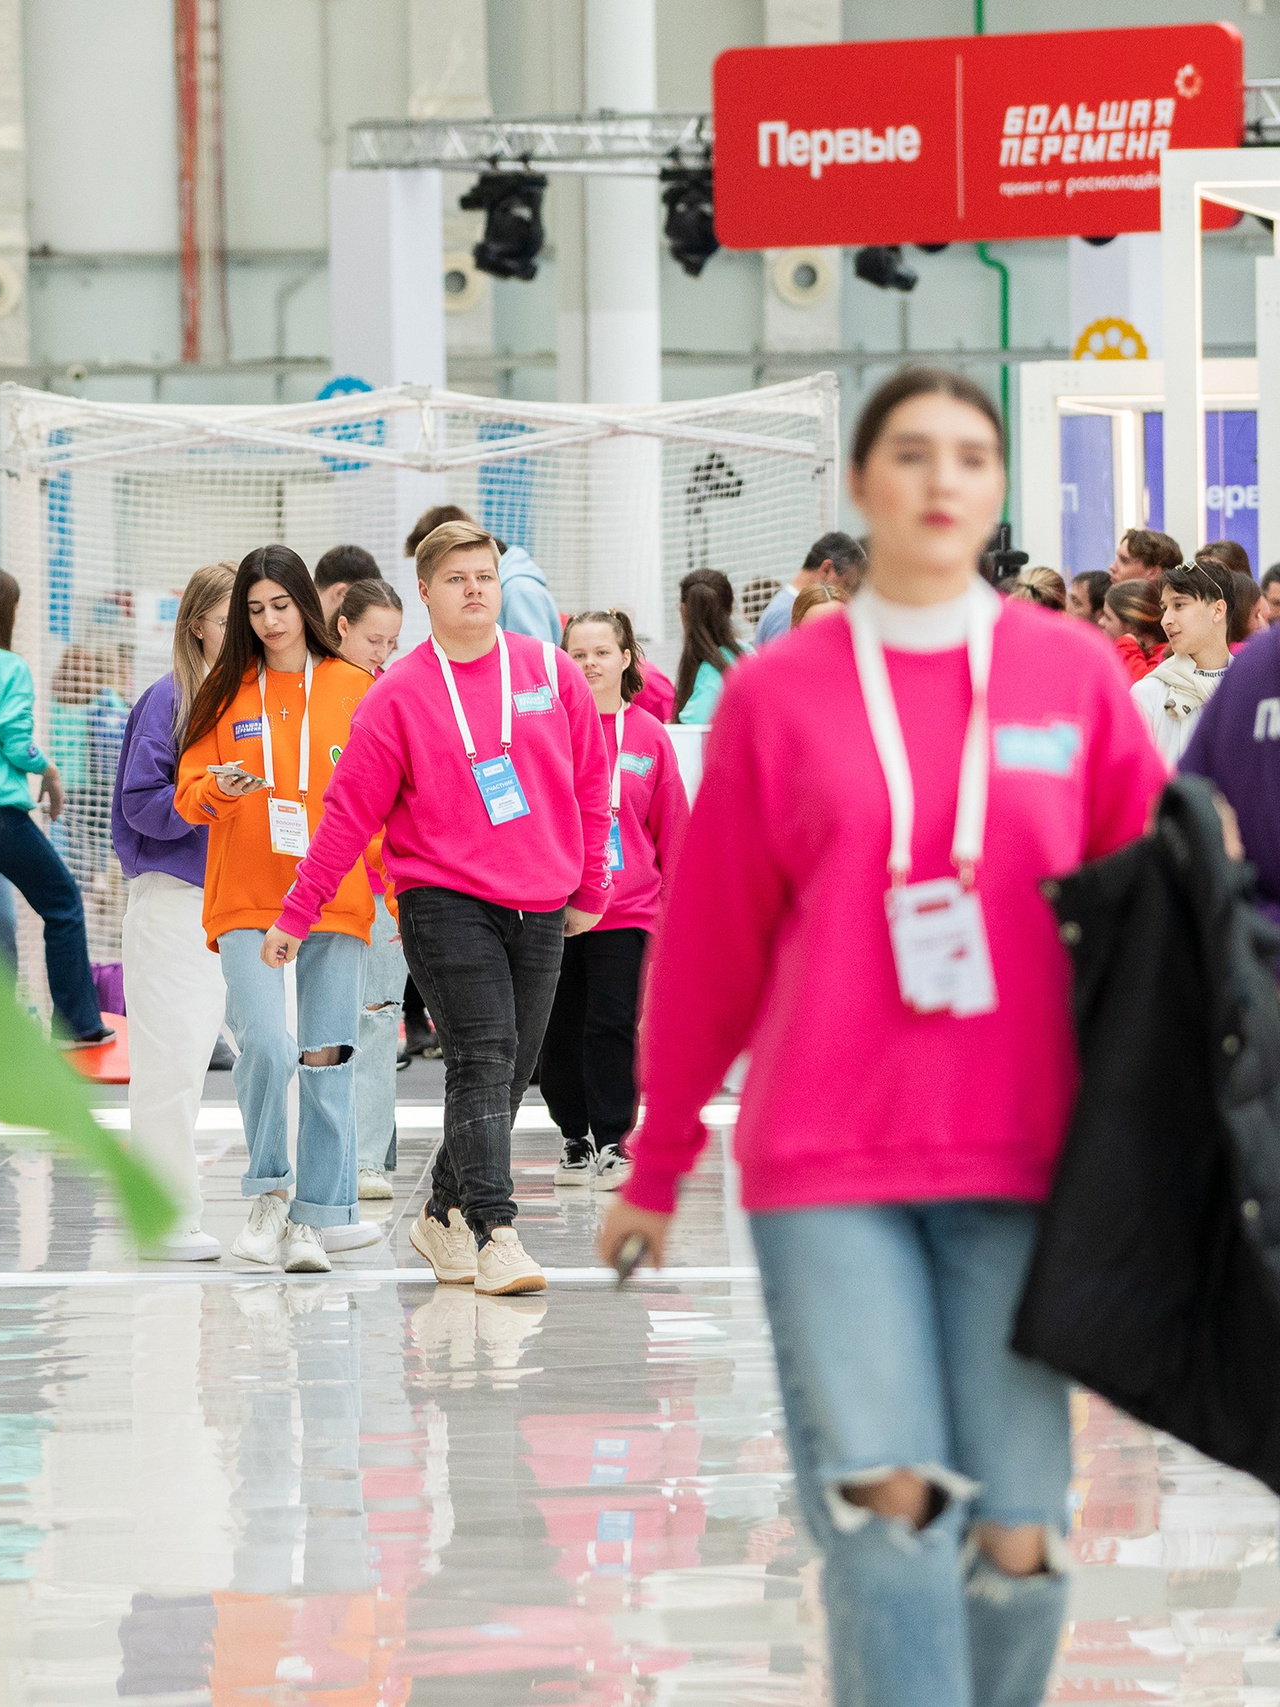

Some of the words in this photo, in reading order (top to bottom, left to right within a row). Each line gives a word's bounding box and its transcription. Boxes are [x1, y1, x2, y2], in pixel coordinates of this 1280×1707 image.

[1003, 98, 1175, 136] БОЛЬШАЯ
[758, 120, 921, 179] Первые
[999, 129, 1170, 167] ПЕРЕМЕНА
